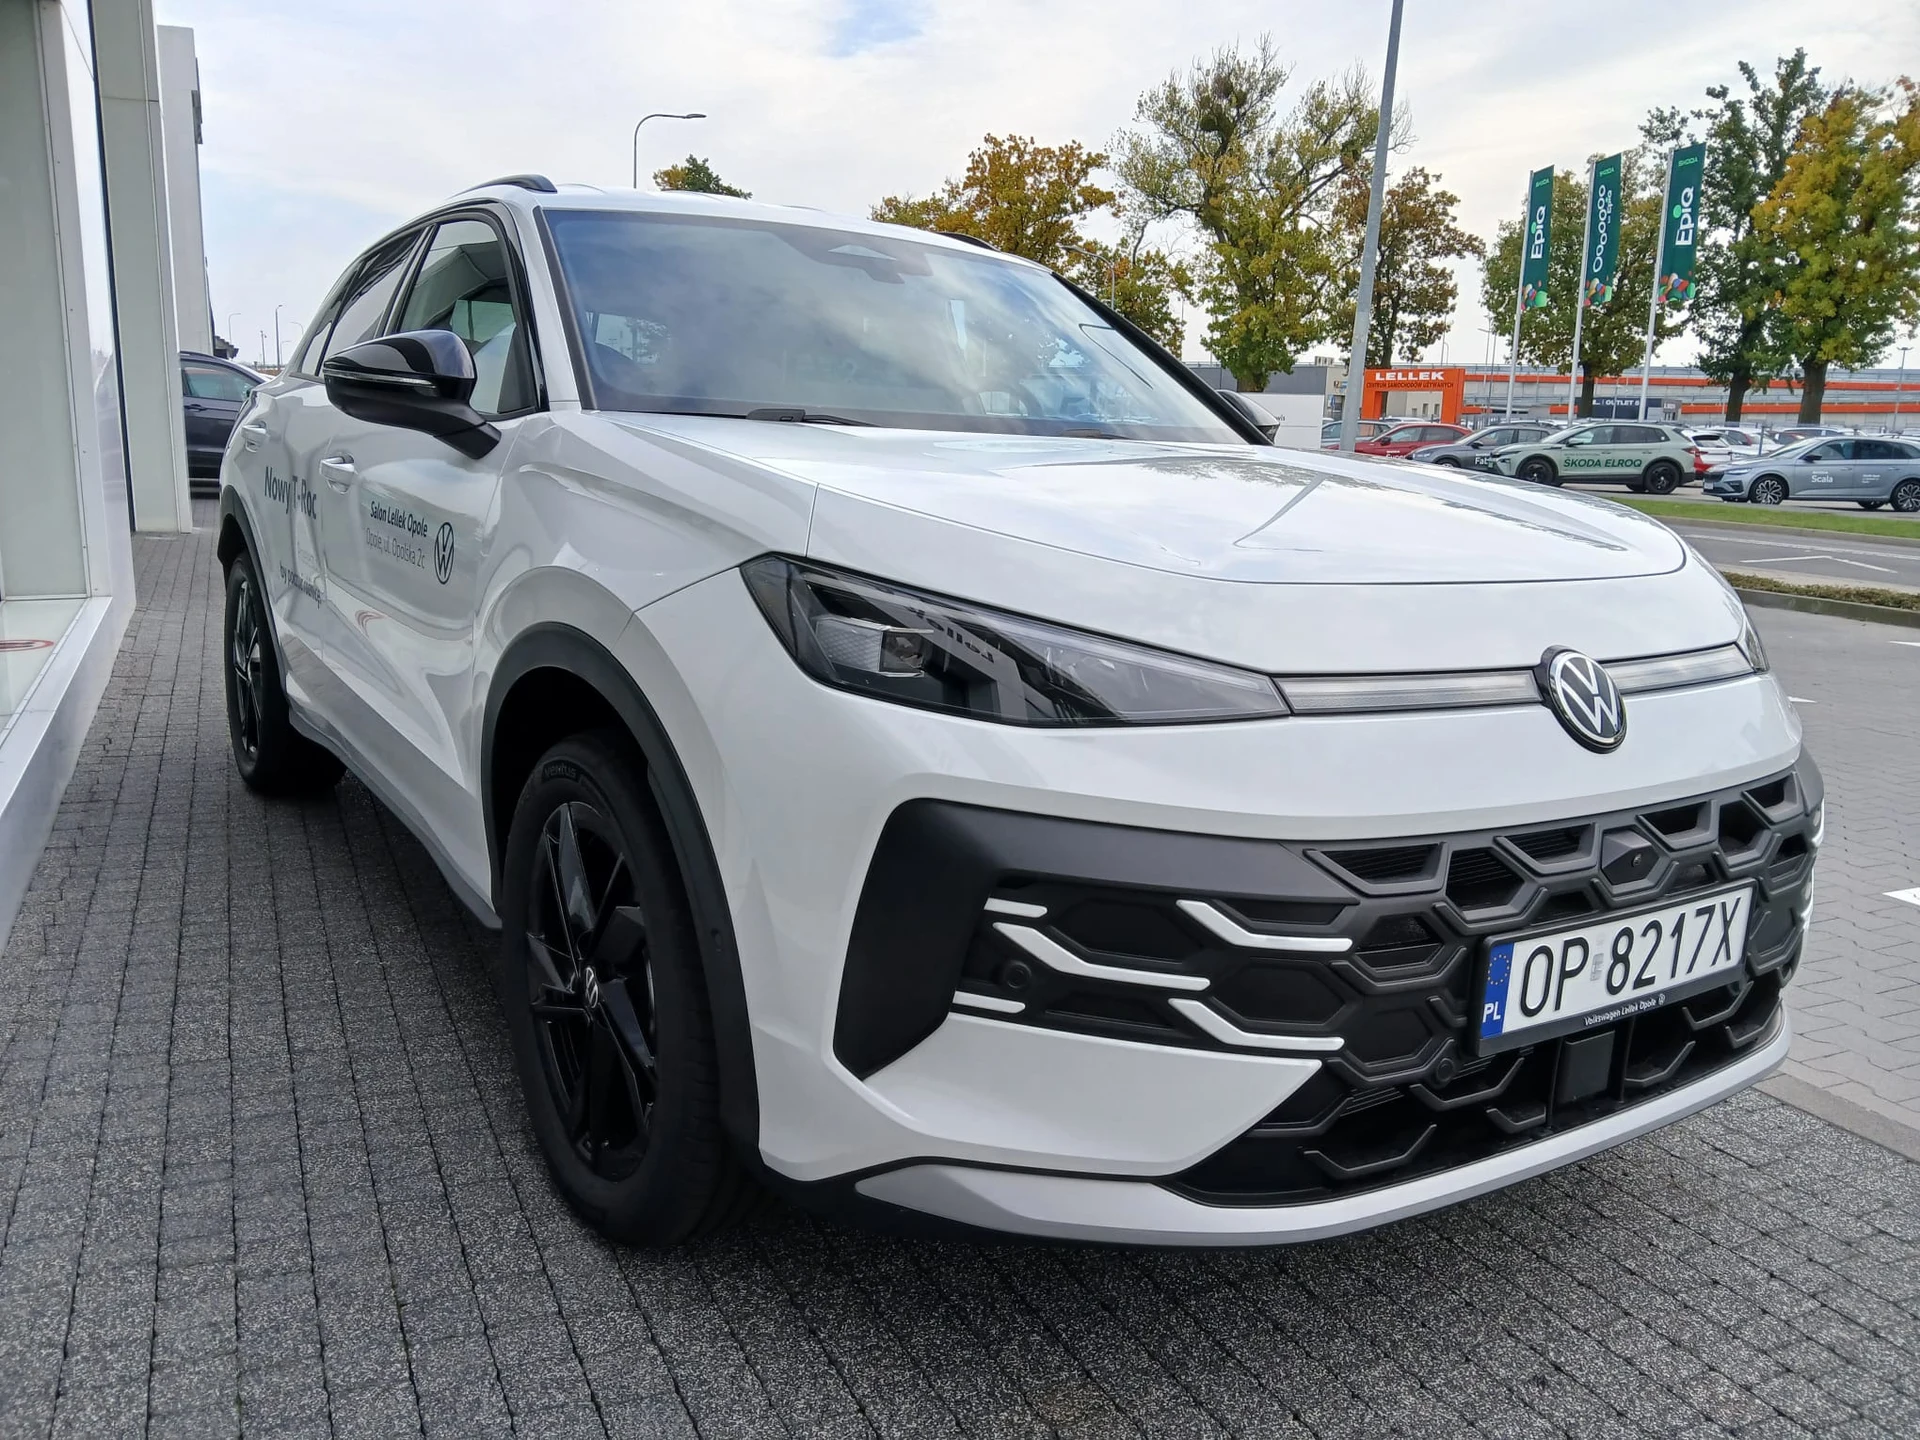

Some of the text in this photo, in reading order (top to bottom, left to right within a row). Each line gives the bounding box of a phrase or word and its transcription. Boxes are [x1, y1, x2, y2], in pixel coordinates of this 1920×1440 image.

[1375, 371, 1445, 381] LELLEK
[1605, 399, 1634, 407] OUTLET
[1563, 457, 1643, 468] ŠKODA ELROQ
[1811, 474, 1834, 483] Scala
[264, 466, 317, 520] Nowy T-Roc
[370, 500, 428, 538] Salon Lellek Opole
[1519, 896, 1742, 1018] OP 8217X
[1482, 1001, 1502, 1024] PL
[1584, 1009, 1621, 1026] Volkswagen
